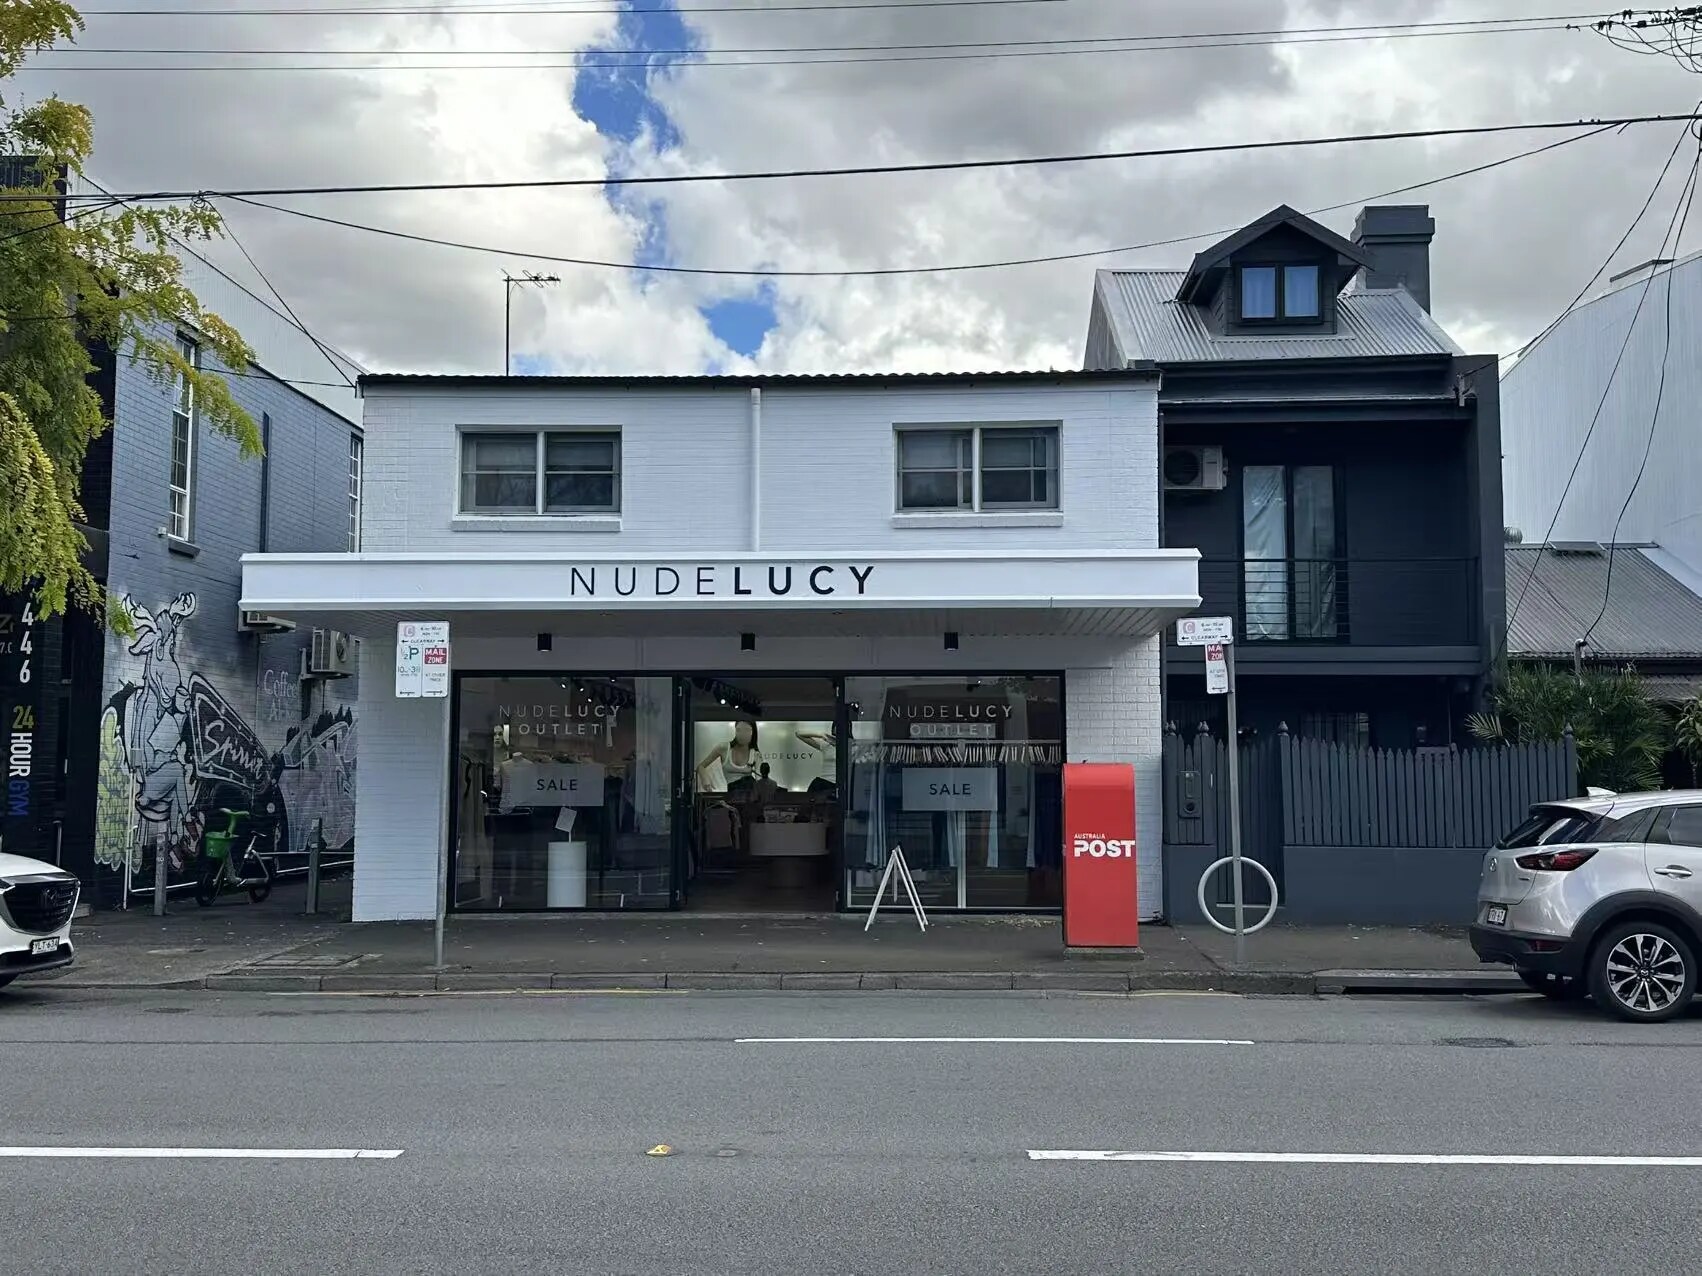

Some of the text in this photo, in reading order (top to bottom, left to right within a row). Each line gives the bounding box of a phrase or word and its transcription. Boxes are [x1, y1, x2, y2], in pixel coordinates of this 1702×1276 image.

[570, 565, 874, 595] NUDELUCY
[425, 648, 446, 656] MAIL
[427, 656, 444, 664] ZONE
[500, 704, 620, 718] NUDELUCY
[889, 705, 1012, 718] NUDELUCY
[518, 723, 600, 735] OUTLET
[910, 724, 992, 736] OUTLET
[8, 705, 34, 816] 24 HOUR GYM
[536, 779, 578, 791] SALE
[929, 783, 972, 795] SALE
[1073, 840, 1136, 858] POST
